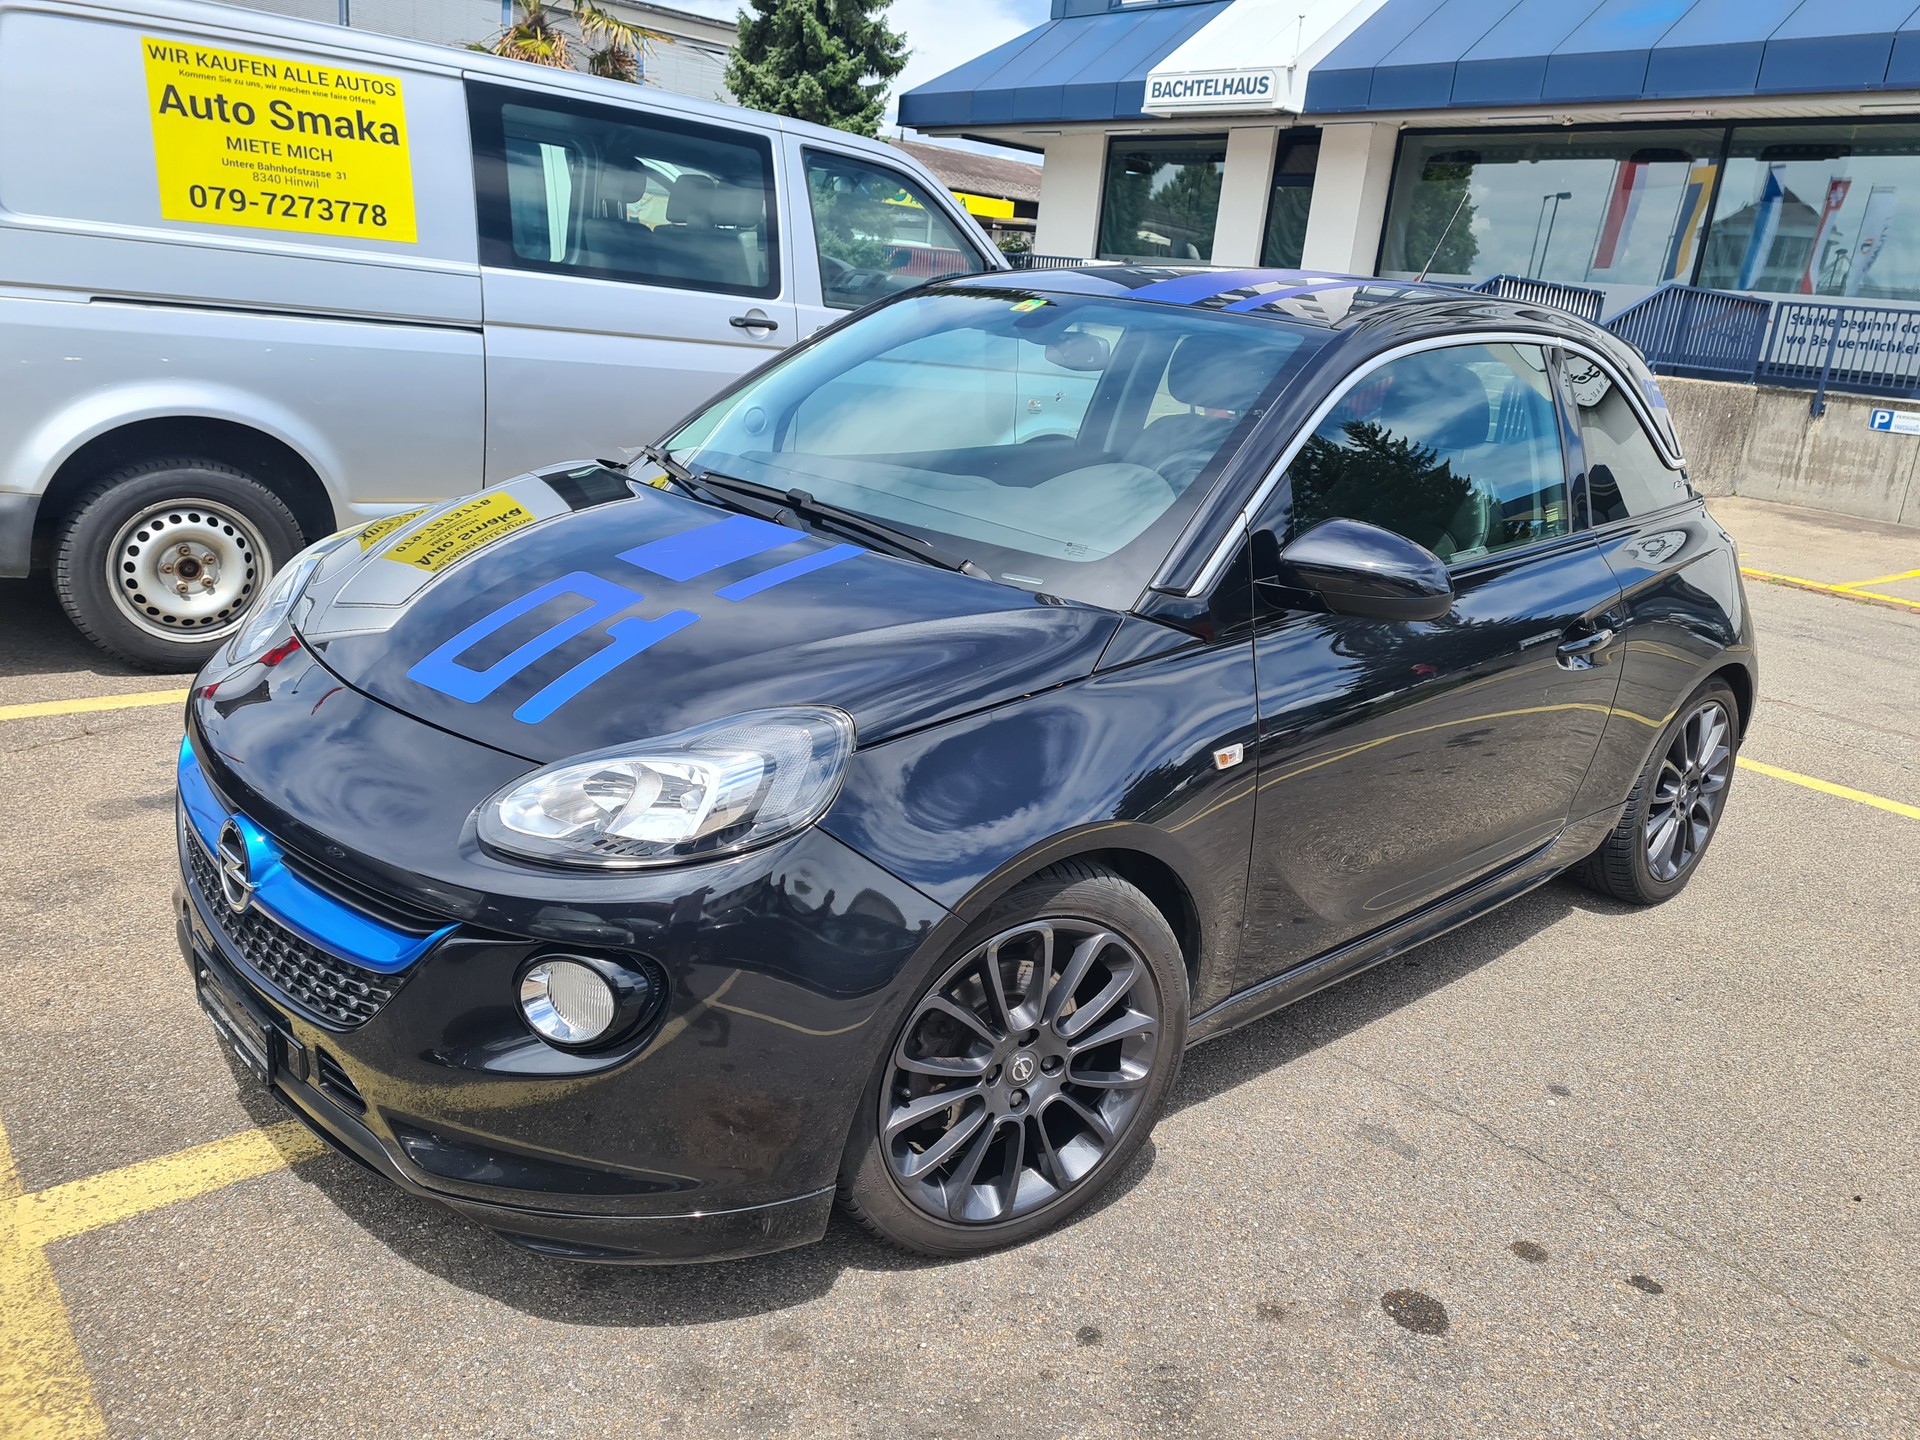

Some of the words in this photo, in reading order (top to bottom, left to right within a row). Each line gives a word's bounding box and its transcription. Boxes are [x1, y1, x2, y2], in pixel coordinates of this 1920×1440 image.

[147, 43, 189, 66] WIR
[195, 51, 277, 79] KAUFEN
[283, 66, 330, 87] ALLE
[335, 74, 397, 97] AUTOS
[178, 68, 217, 82] Kommen
[219, 74, 232, 84] Sie
[265, 82, 278, 91] wir
[279, 84, 311, 96] machen
[312, 89, 329, 98] eine
[330, 91, 348, 101] faire
[349, 94, 376, 105] Offerte
[1151, 75, 1269, 98] BACHTELHAUS
[158, 84, 256, 125] Auto
[269, 99, 400, 146] Smaka
[226, 136, 282, 157] MIETE
[287, 144, 333, 162] MICH
[221, 158, 255, 170] Untere
[258, 162, 332, 179] Bahnhofstrasse
[336, 172, 347, 181] 31
[252, 172, 281, 185] 8340
[284, 175, 320, 189] Hinwil
[189, 184, 388, 227] 079-7273778
[1786, 335, 1806, 345] wo
